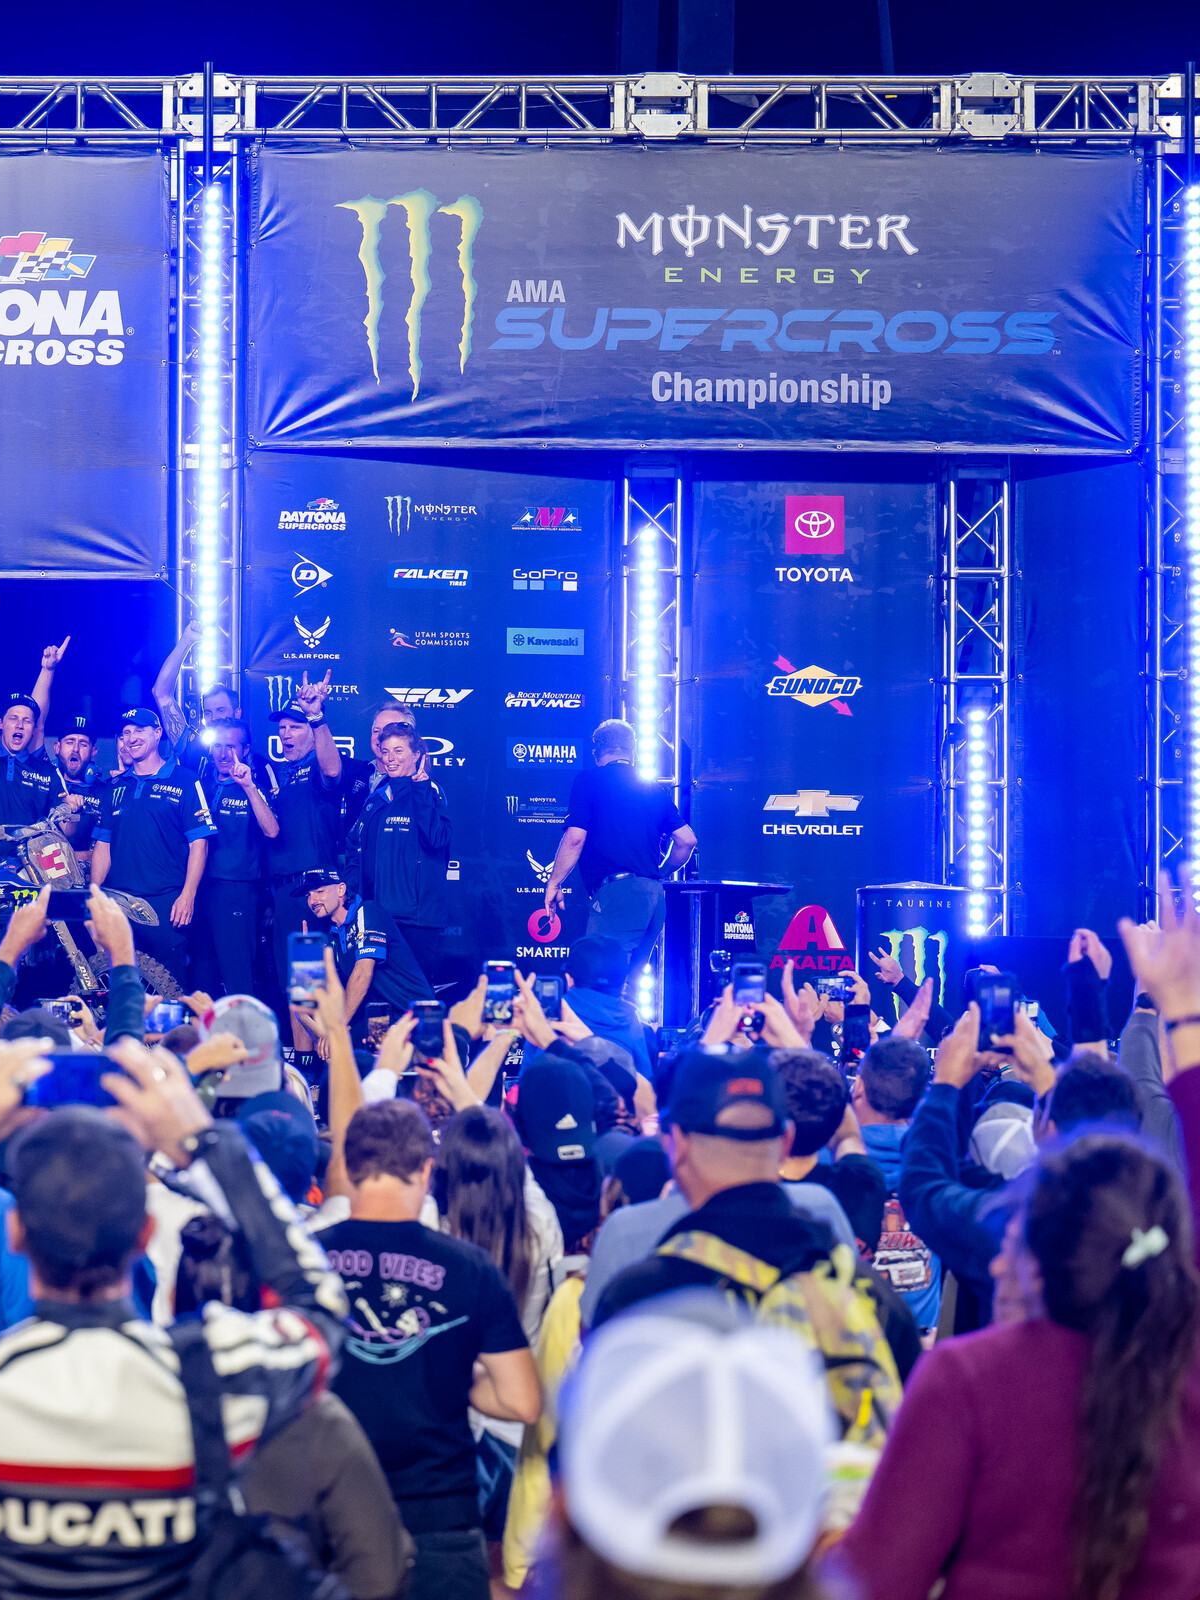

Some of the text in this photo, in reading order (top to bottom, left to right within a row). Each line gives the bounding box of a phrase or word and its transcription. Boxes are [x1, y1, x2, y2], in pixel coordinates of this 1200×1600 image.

[616, 205, 918, 257] MONSTER
[666, 267, 871, 284] ENERGY
[507, 280, 566, 303] AMA
[487, 307, 1060, 355] SUPERCROSS
[651, 370, 892, 410] Championship
[414, 503, 477, 516] MONSTER
[279, 511, 346, 523] DAYTONA
[278, 522, 346, 531] SUPERCROSS
[394, 568, 468, 580] FALKEN
[513, 568, 578, 580] GoPro
[775, 568, 853, 582] TOYOTA
[526, 636, 579, 648] Kawasaki
[770, 678, 858, 694] SUNOCO
[384, 688, 474, 704] FLY
[527, 744, 577, 759] YAMAHA
[763, 824, 864, 836] CHEVROLET
[886, 900, 952, 908] TAURINE
[724, 922, 754, 934] DAYTONA
[516, 946, 570, 958] SMARTFI
[769, 954, 855, 970] AXALTA
[326, 1250, 446, 1291] OOD VIBES
